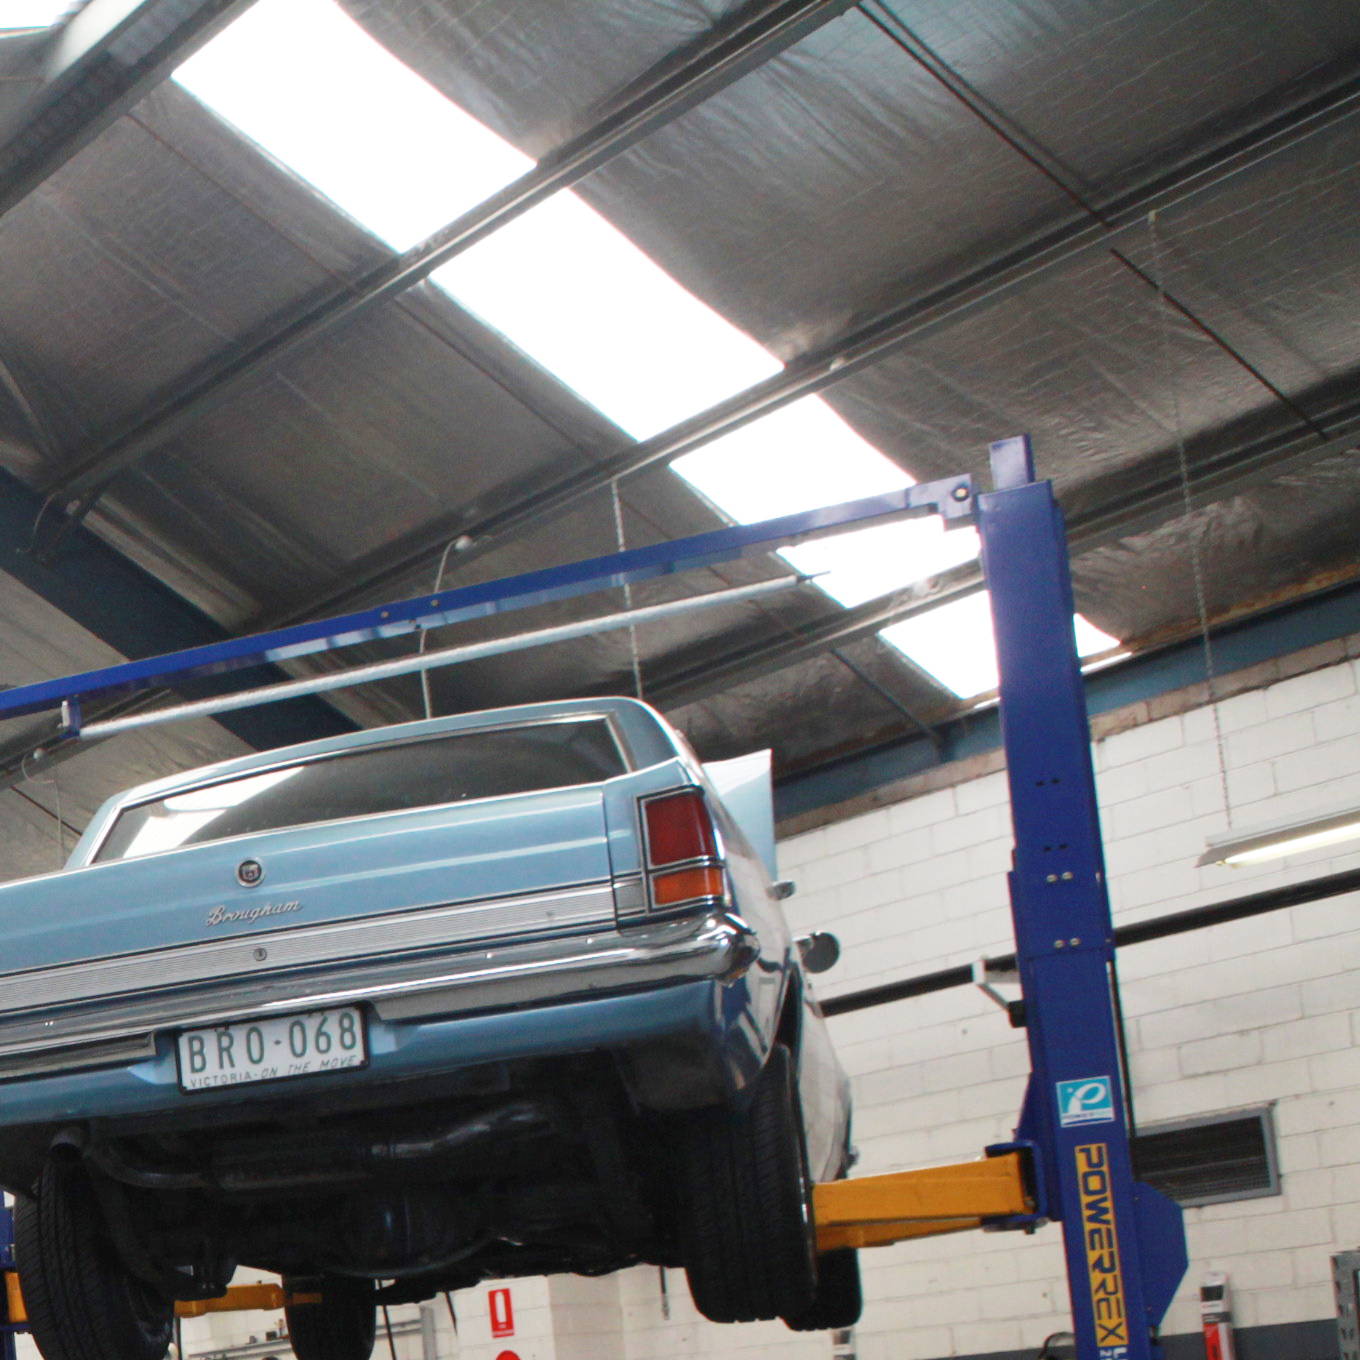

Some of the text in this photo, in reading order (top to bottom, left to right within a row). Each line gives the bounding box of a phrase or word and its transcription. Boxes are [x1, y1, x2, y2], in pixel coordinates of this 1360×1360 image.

[205, 900, 304, 927] Brougham
[287, 1061, 311, 1074] THE
[319, 1054, 357, 1069] MOVE
[1080, 1145, 1126, 1344] POWERREX
